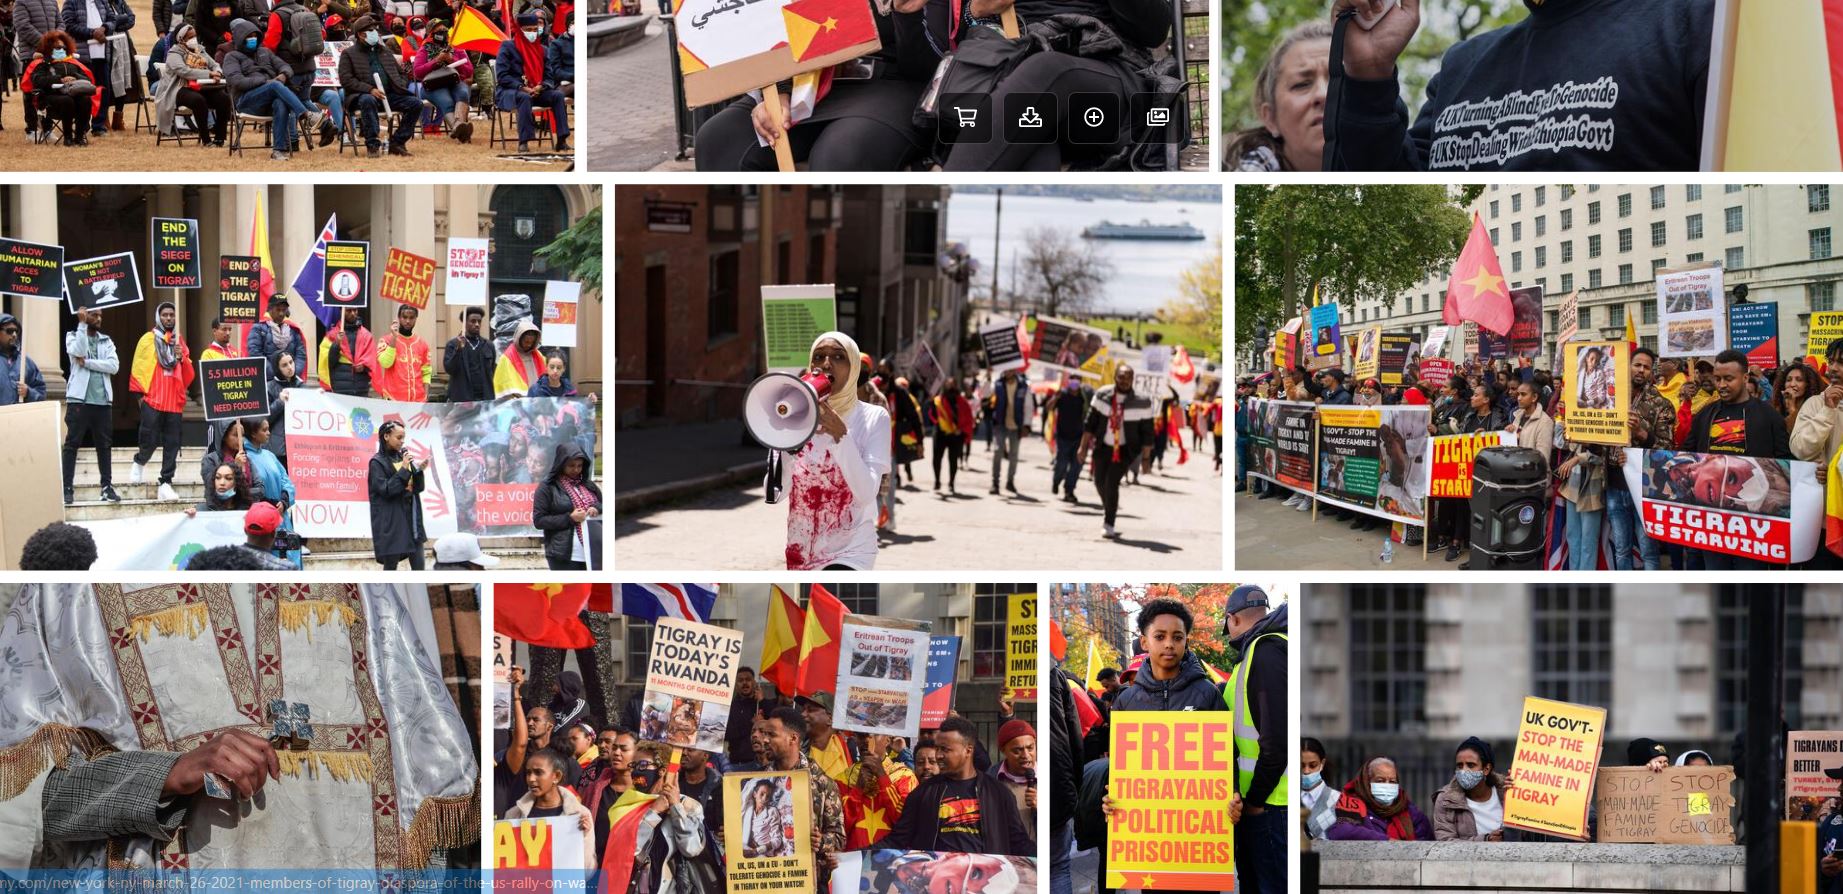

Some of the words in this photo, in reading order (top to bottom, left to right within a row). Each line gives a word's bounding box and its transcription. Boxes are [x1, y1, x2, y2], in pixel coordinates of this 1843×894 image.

[162, 222, 187, 232] END
[162, 236, 186, 246] THE
[11, 245, 43, 256] ALLOW
[160, 250, 191, 260] SIEGE
[168, 264, 184, 272] ON
[229, 261, 250, 270] END
[388, 250, 434, 280] HELP
[450, 260, 486, 268] GENOCIDE
[14, 266, 39, 276] ACCES
[451, 270, 459, 278] in
[20, 276, 32, 284] TO
[158, 276, 196, 286] TIGRAY
[230, 276, 248, 286] THE
[11, 284, 38, 294] TIGRAY
[382, 271, 430, 307] TIGRAY
[221, 292, 256, 302] TIGRAY
[224, 307, 256, 317] SIEGE!!
[1818, 314, 1843, 326] STOP
[208, 370, 221, 379] 5.5
[222, 367, 258, 378] MILLION
[217, 380, 244, 390] PEOPLE
[244, 380, 252, 388] IN
[222, 391, 248, 400] TIGRAY
[213, 404, 232, 412] NEED
[292, 410, 346, 432] STOP
[1292, 430, 1304, 440] AND
[1346, 438, 1370, 446] FAMINE
[351, 456, 361, 464] to
[292, 466, 317, 480] rape
[476, 488, 493, 502] be
[496, 491, 504, 502] a
[294, 504, 349, 525] NOW
[476, 508, 500, 522] the
[1652, 504, 1770, 539] TIGRAY
[1646, 521, 1665, 536] IS
[1670, 526, 1786, 559] STARVING
[658, 624, 722, 650] TIGRAY
[725, 638, 742, 654] IS
[854, 632, 885, 642] Eritrean
[888, 634, 914, 644] Troops
[858, 642, 872, 651] Out
[884, 646, 908, 656] Tigray
[655, 642, 730, 670] TODAY'S
[651, 659, 730, 688] RWANDA
[656, 679, 686, 690] MONTHS
[696, 686, 730, 698] GENOCIDE
[1526, 712, 1545, 726] UK
[1114, 722, 1228, 770] FREE
[1522, 730, 1557, 746] STOP
[1560, 737, 1584, 752] THE
[1794, 740, 1838, 752] TIGRAYANS
[1518, 749, 1592, 774] MAN-MADE
[1794, 760, 1820, 772] BETTER
[1514, 768, 1564, 788] FAMINE
[1565, 778, 1580, 792] IN
[1606, 776, 1654, 792] STOP
[1670, 772, 1728, 792] STOP
[1114, 778, 1228, 800] TIGRAYANS
[1511, 786, 1560, 806] TIGRAY
[1603, 795, 1660, 811] MAN-MADE
[1671, 794, 1728, 814] TIGRAY
[1112, 808, 1229, 834] POLITICAL
[1604, 812, 1656, 826] FAMINE
[1670, 818, 1730, 834] GENOCIDE
[1616, 828, 1656, 837] TIGRAY
[1111, 840, 1230, 864] PRISONERS
[738, 862, 746, 870] UK,
[748, 862, 756, 870] US,
[772, 860, 778, 868] EU
[756, 871, 781, 880] GENOCIDE
[788, 870, 808, 878] FAMINE
[740, 882, 759, 890] TIGRAY
[760, 882, 768, 890] ON
[769, 881, 783, 889] YOUR
